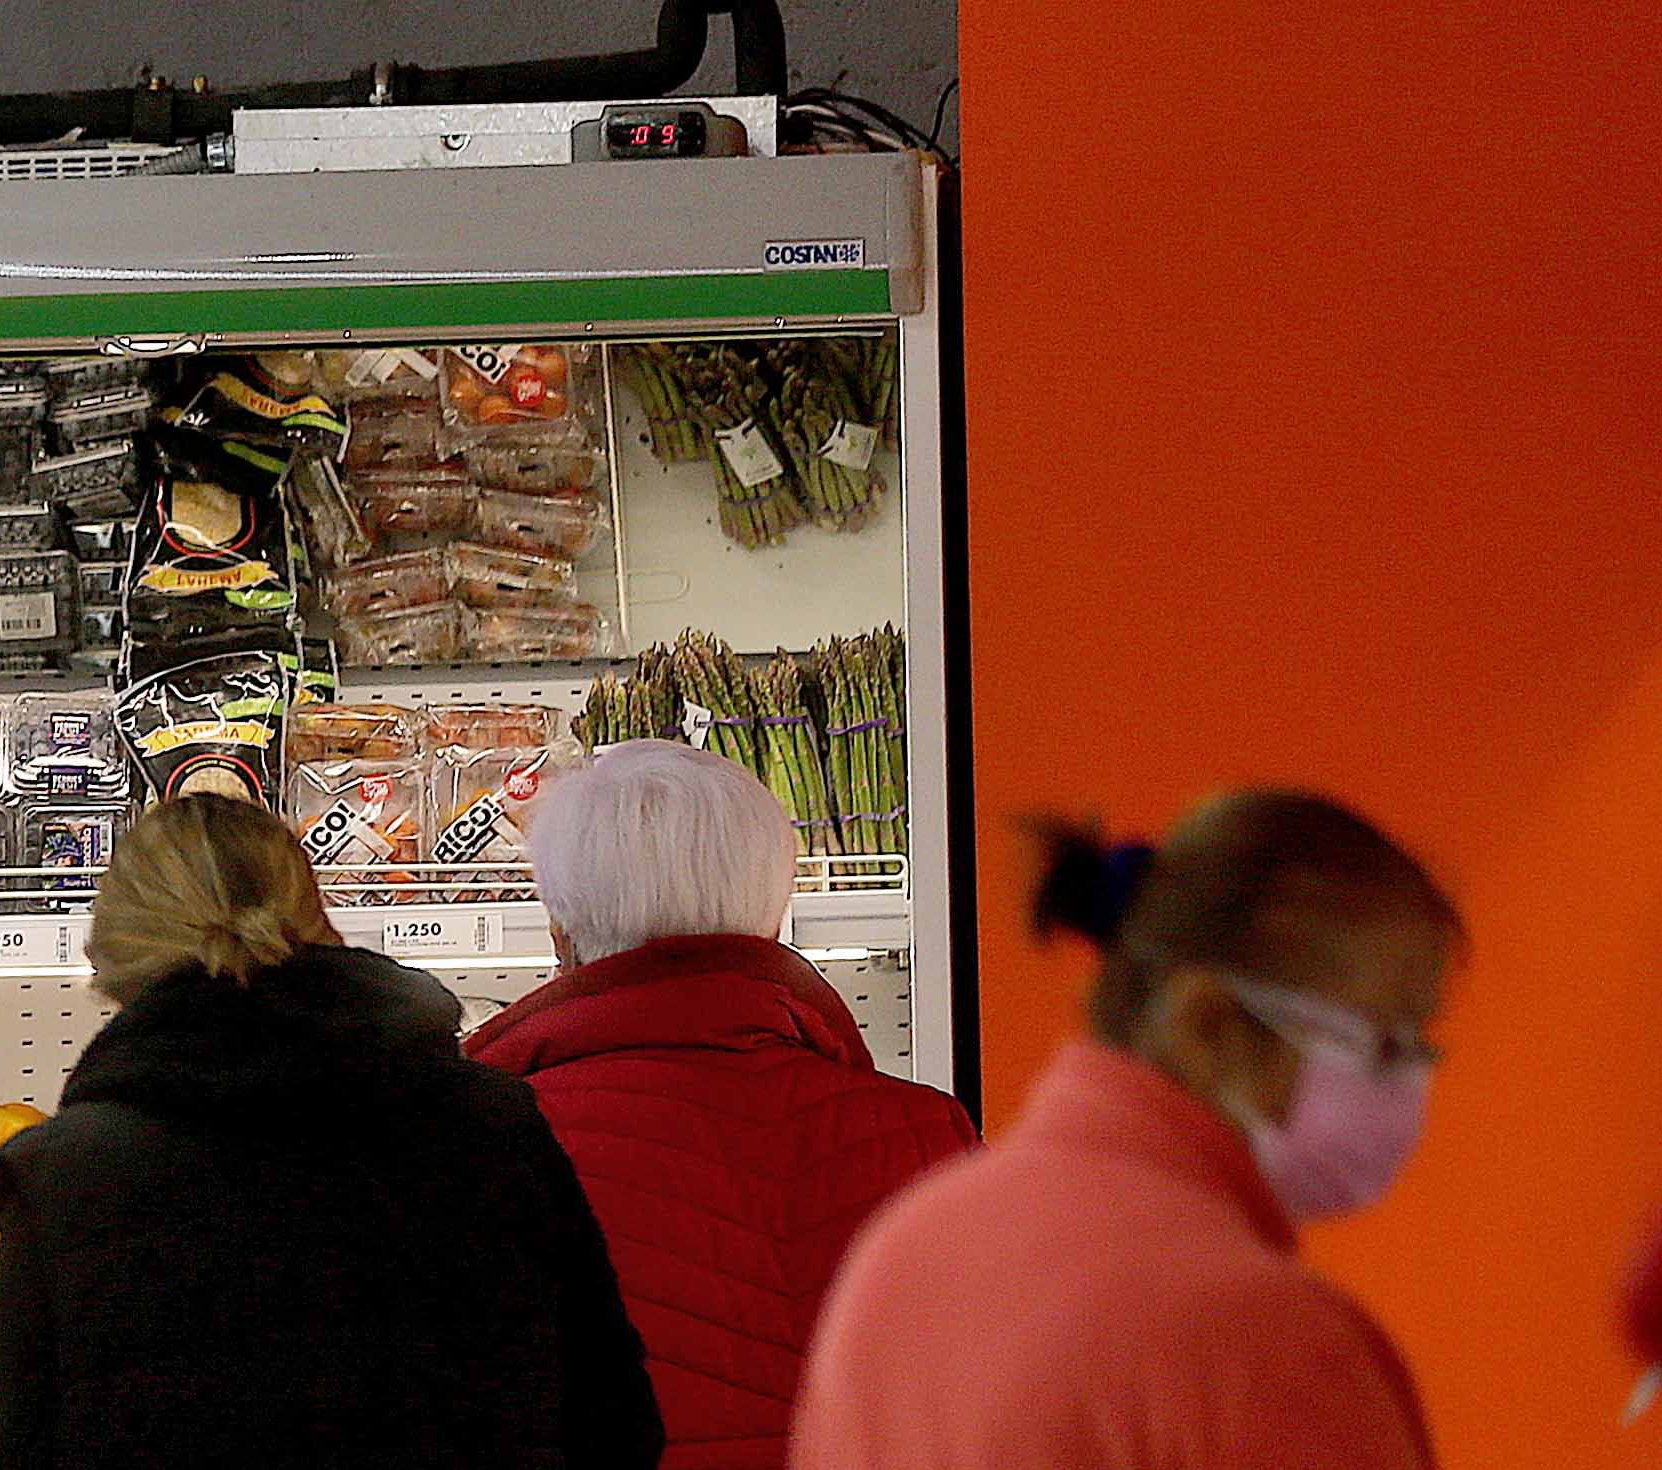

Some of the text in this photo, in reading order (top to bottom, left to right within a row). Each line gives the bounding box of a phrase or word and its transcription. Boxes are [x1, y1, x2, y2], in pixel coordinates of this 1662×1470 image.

[765, 246, 838, 265] COSTAN
[309, 799, 357, 856] ICO!
[433, 797, 501, 863] RICO!
